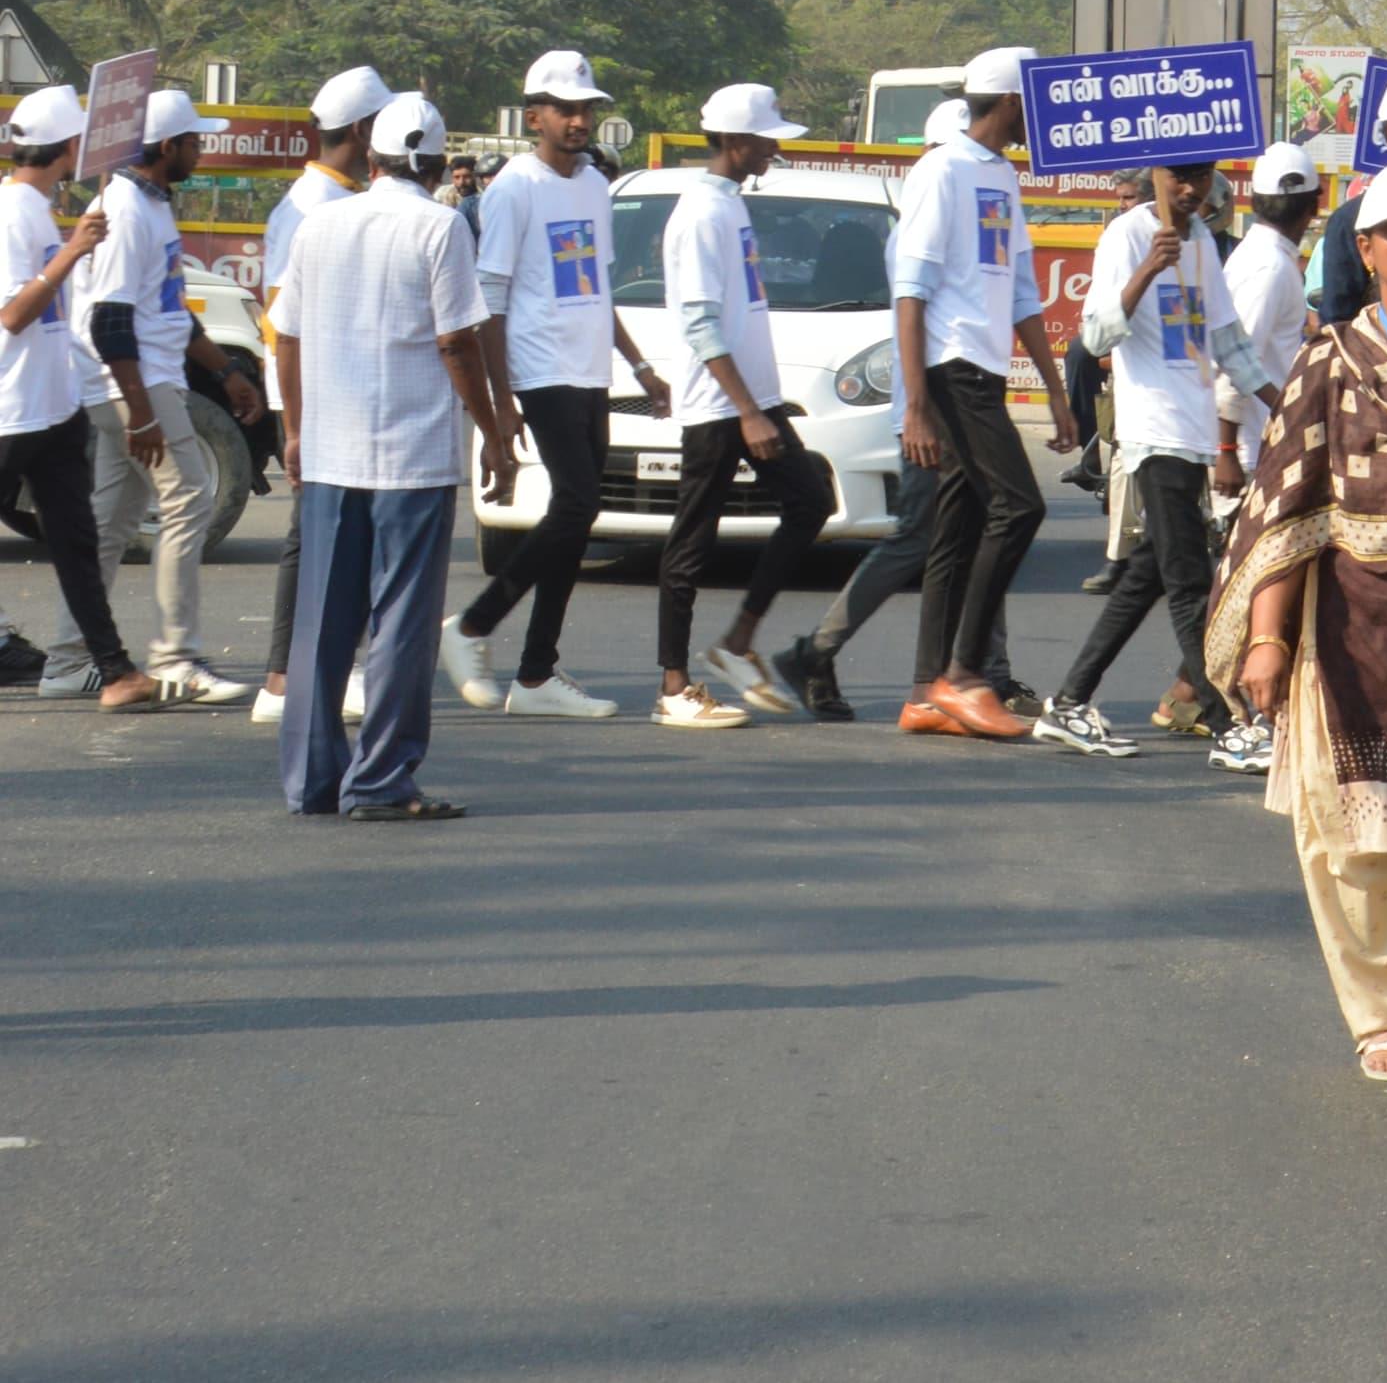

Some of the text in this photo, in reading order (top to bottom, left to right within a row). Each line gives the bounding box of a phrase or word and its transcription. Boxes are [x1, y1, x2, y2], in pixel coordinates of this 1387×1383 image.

[1295, 49, 1367, 58] PHOTO STUDIO
[1048, 65, 1104, 105] என்
[1049, 109, 1104, 149] என்
